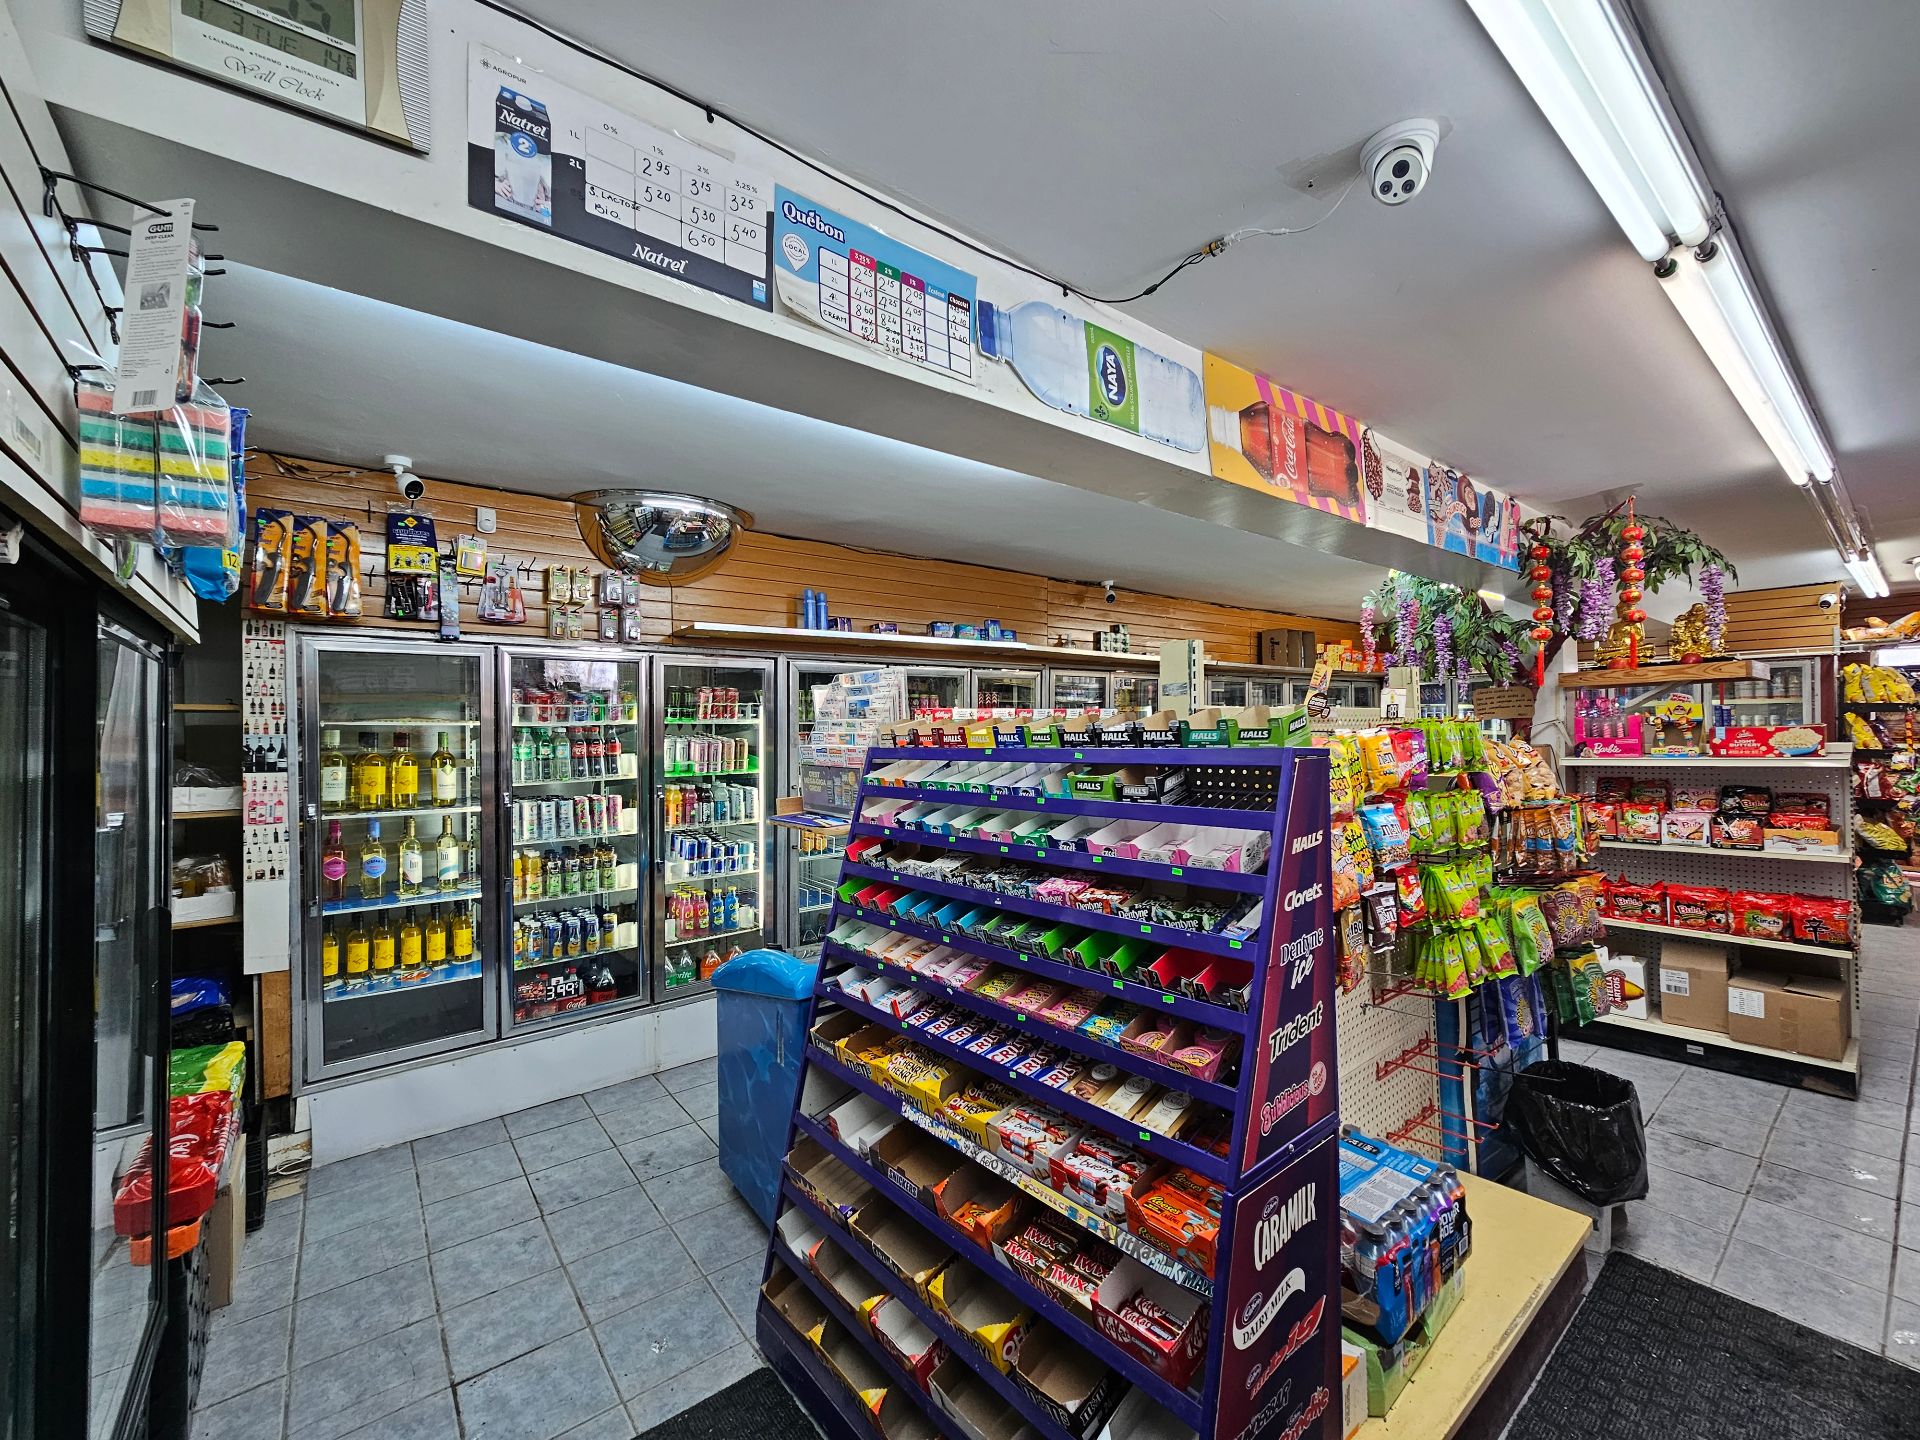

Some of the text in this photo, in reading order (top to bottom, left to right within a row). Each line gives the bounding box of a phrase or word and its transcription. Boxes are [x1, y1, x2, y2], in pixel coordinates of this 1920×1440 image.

[224, 55, 326, 102] Wall Clock
[492, 65, 527, 85] AGROPUR
[499, 108, 548, 138] Natrel
[147, 221, 174, 234] GUM
[782, 200, 846, 244] Québon
[784, 240, 808, 257] LOCAL
[631, 243, 689, 274] Natrel
[1126, 345, 1134, 379] NATURELLE
[1104, 353, 1119, 401] NAYA
[1289, 715, 1308, 733] HALLS
[942, 734, 963, 744] HALLS
[970, 735, 990, 744] HALLS
[997, 733, 1021, 743] HALLS
[1032, 734, 1051, 743] HALLS
[1063, 732, 1091, 743] HALLS
[1101, 731, 1131, 742] HALLS
[1142, 731, 1175, 742] HALLS
[1191, 731, 1218, 741] HALLS
[1239, 730, 1270, 739] HALLS
[1593, 742, 1622, 754] Barbie
[1076, 781, 1101, 791] HALLS
[1124, 786, 1148, 796] HALLS
[1291, 829, 1324, 855] HALLS
[1283, 881, 1324, 913] Clorets
[1076, 901, 1104, 912] Dentyne
[1118, 908, 1149, 921] Dentyne
[1163, 917, 1199, 929] Dentyne
[1751, 914, 1781, 927] Kimchi
[1279, 927, 1324, 967] Dentyne
[1290, 952, 1315, 990] ice
[1605, 976, 1613, 1001] STELLA
[1613, 976, 1622, 1002] ARTOIS
[1268, 1000, 1324, 1064] Trident
[1260, 1079, 1310, 1137] Bubblicious
[1013, 1120, 1042, 1135] bueno
[1079, 1158, 1115, 1176] bueno
[887, 1167, 919, 1199] SNICKERS
[1148, 1195, 1184, 1217] Reese's
[1253, 1182, 1318, 1272] CARAMILK
[1122, 1307, 1153, 1329] KitKat
[1242, 1279, 1293, 1346] DAIRY MILK
